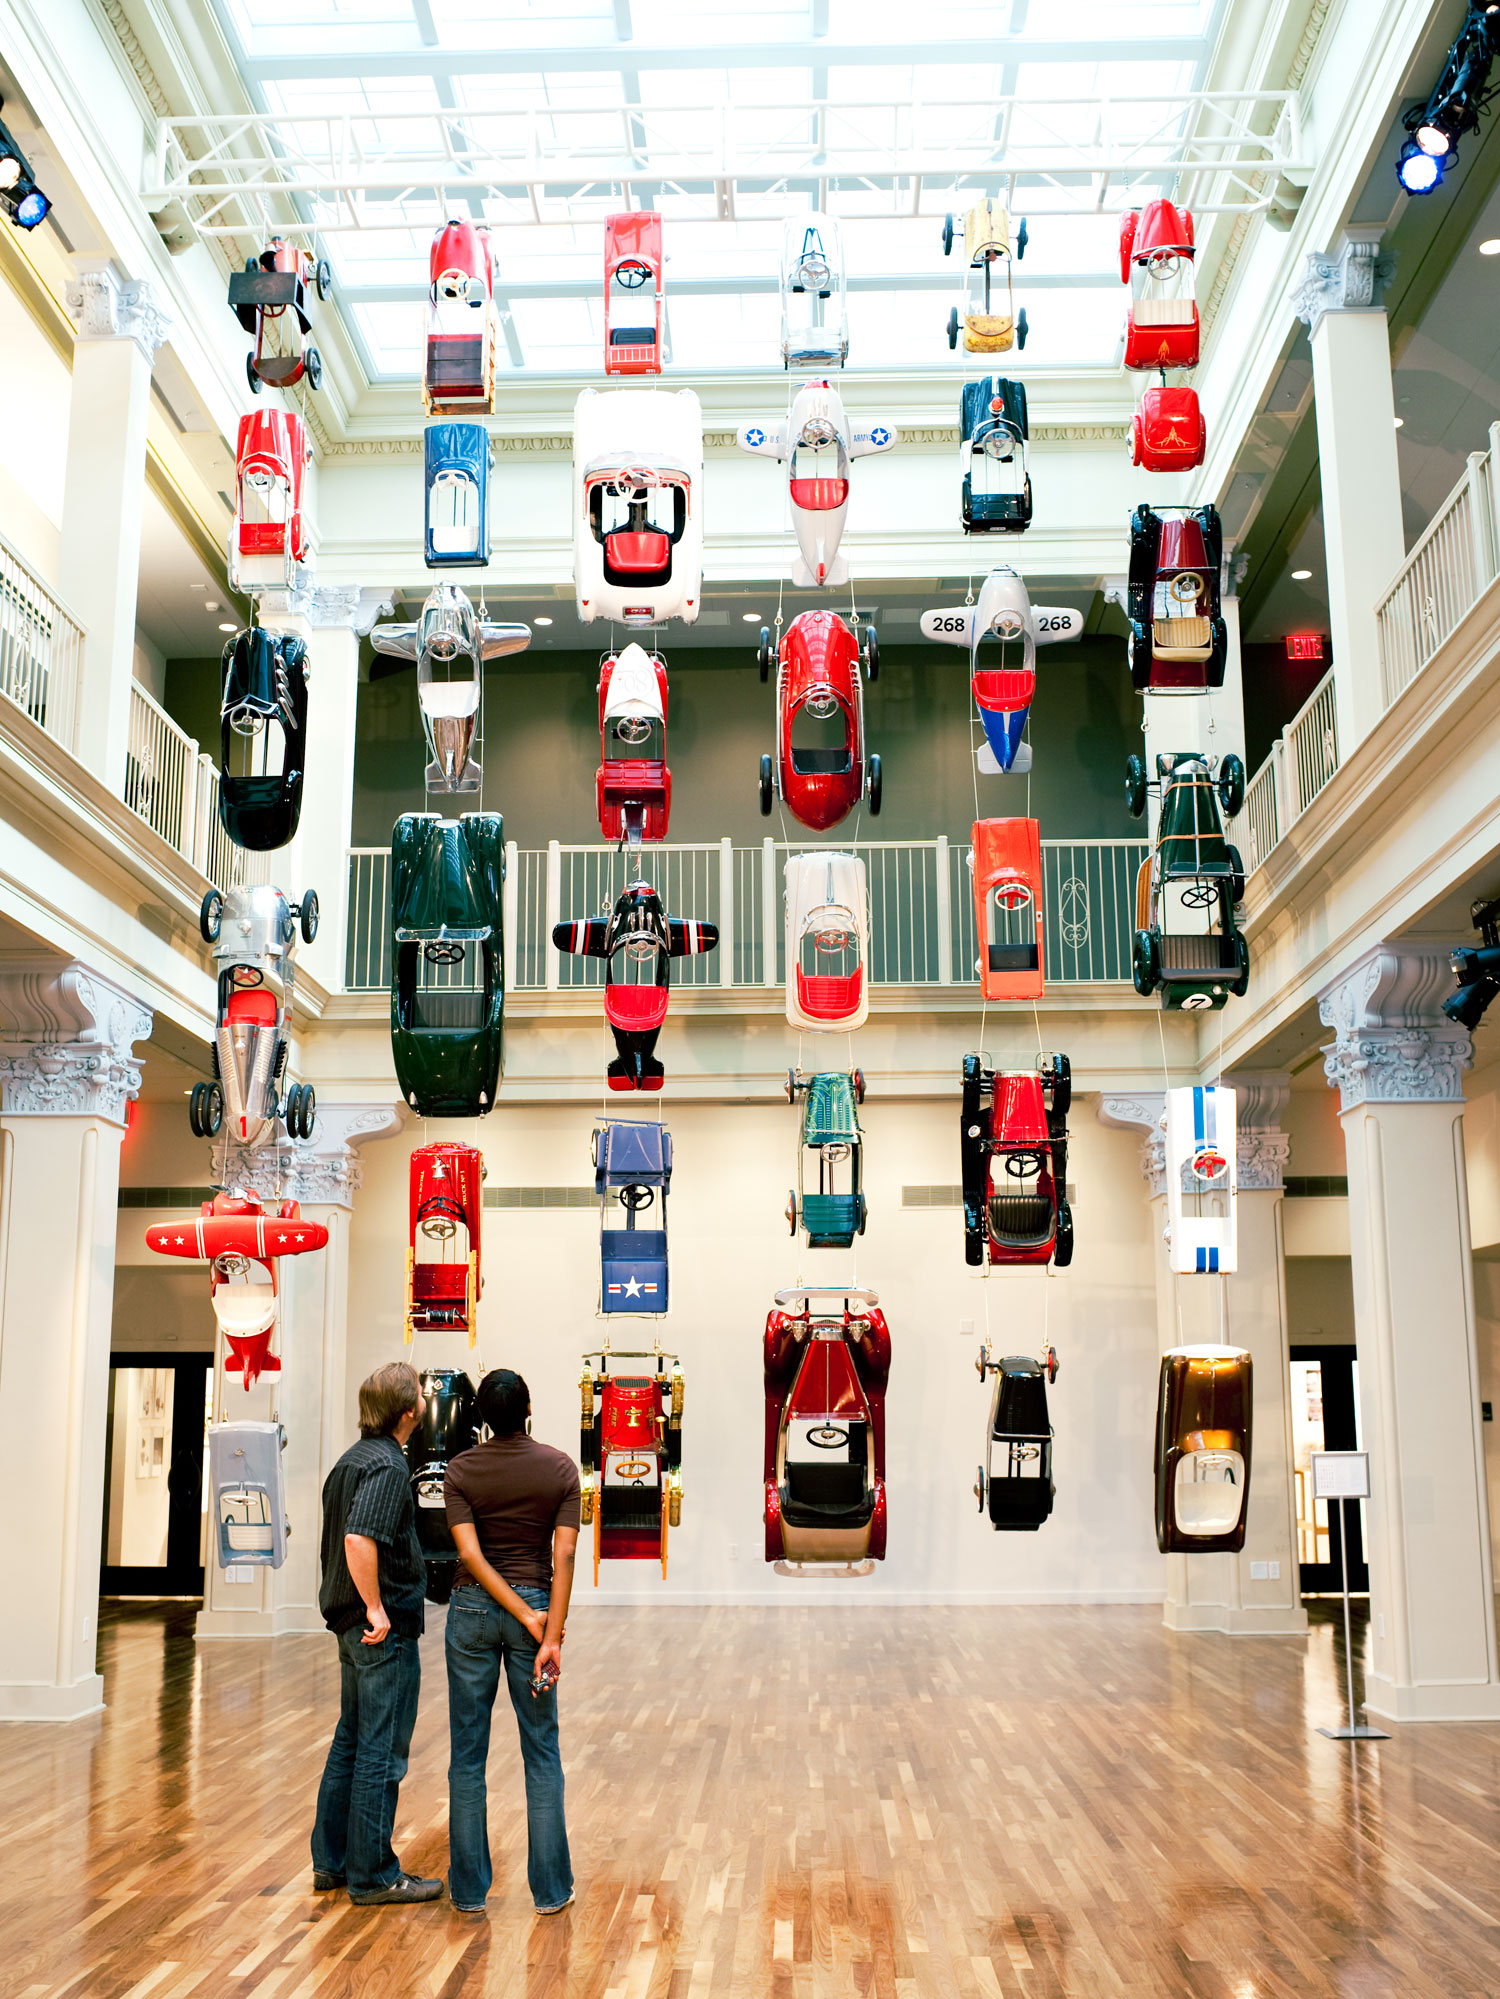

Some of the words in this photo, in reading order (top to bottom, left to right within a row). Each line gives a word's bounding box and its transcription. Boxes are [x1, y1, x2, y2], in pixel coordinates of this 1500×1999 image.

[853, 434, 870, 442] ARMY
[932, 617, 965, 632] 268
[1038, 615, 1072, 632] 268
[1293, 638, 1317, 656] EXIT
[1190, 998, 1206, 1009] 7
[239, 1115, 247, 1138] 1
